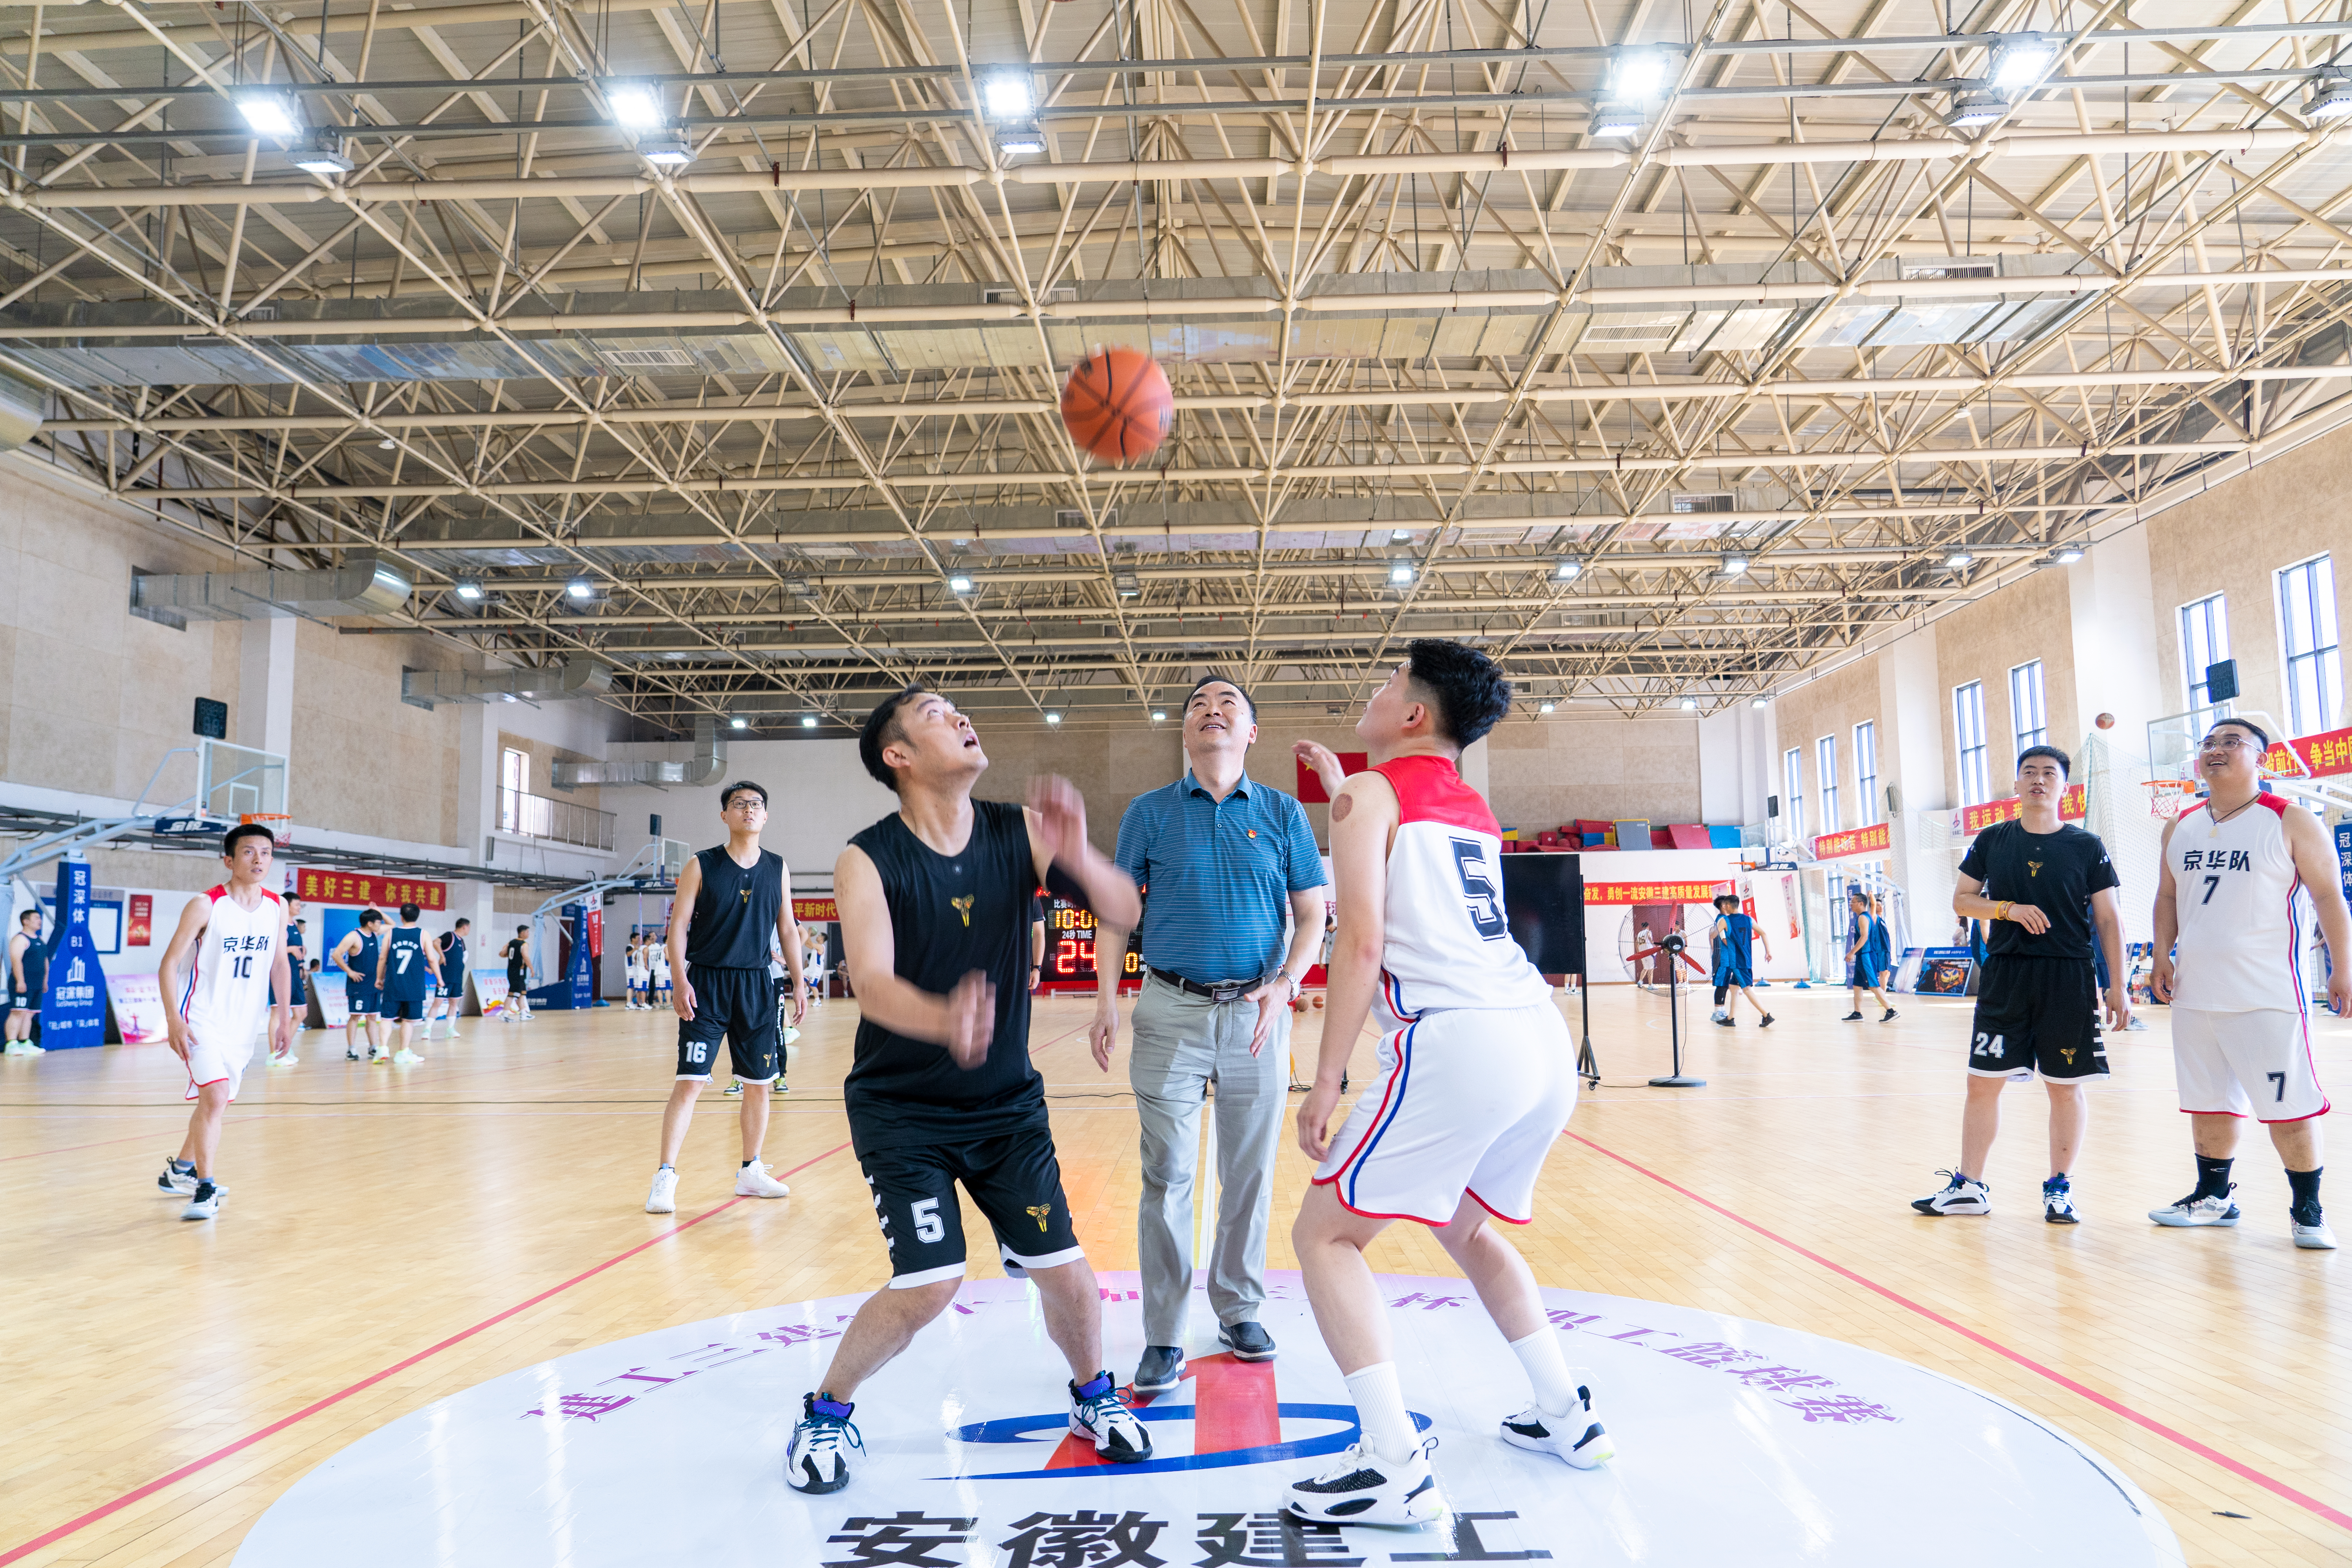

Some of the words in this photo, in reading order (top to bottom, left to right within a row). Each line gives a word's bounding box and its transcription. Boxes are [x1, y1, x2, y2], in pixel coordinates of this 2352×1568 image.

[1969, 805, 2005, 830] 我运动
[1818, 833, 1856, 856] 特别能吃苦
[1860, 827, 1890, 849] 特别能
[2183, 849, 2250, 872] 京华队
[305, 874, 371, 901] 美好三建
[385, 882, 440, 906] 你我共建
[1448, 835, 1508, 942] 5
[2201, 875, 2221, 905] 7
[793, 902, 837, 918] 平新时代
[1054, 899, 1076, 909] 比赛时
[1056, 909, 1098, 929] 10:0
[70, 935, 83, 947] B1
[223, 935, 270, 954] 京华队
[1062, 929, 1075, 939] 24秒
[1076, 930, 1093, 939] TIME
[396, 949, 413, 975] 7
[1057, 940, 1097, 973] 24
[1125, 952, 1138, 973] 0
[15, 996, 27, 1007] 10
[437, 987, 448, 996] 24
[355, 1000, 363, 1011] 6
[686, 1041, 707, 1063] 16
[1973, 1032, 2004, 1058] 24
[2266, 1071, 2287, 1102] 7
[911, 1197, 945, 1243] 5
[818, 1509, 1554, 1568] 安徽建工
